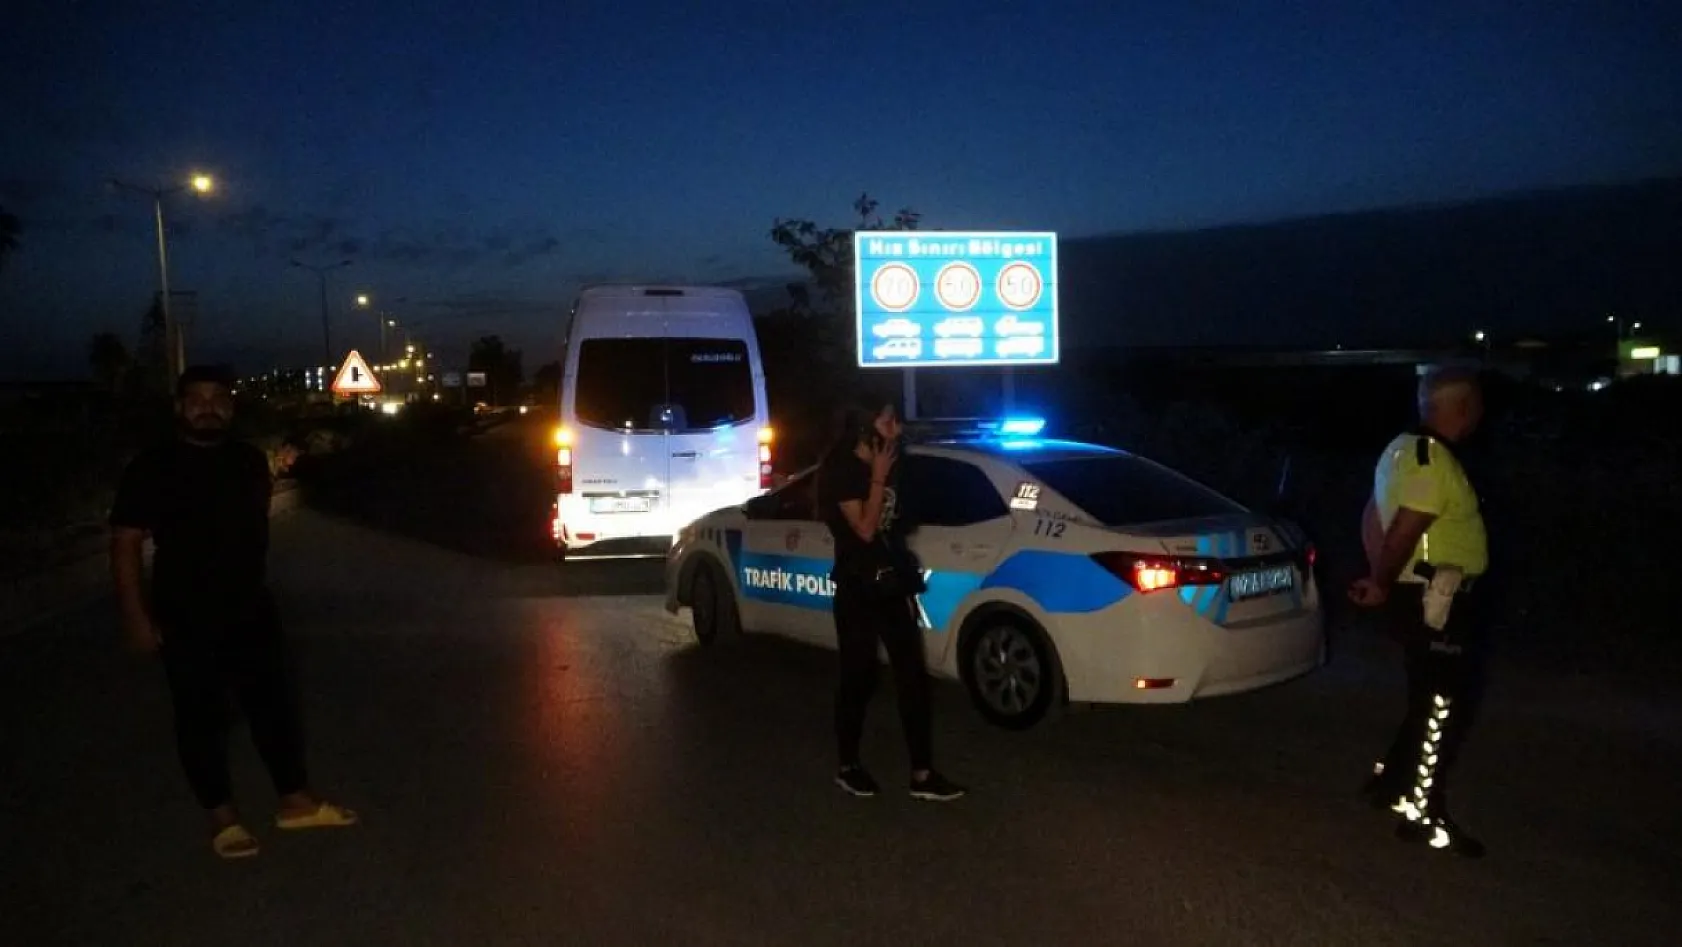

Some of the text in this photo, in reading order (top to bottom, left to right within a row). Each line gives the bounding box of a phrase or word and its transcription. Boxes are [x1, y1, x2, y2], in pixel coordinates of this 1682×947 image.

[1005, 274, 1034, 296] 50
[1034, 518, 1067, 538] 112
[744, 566, 794, 592] TRAFİK
